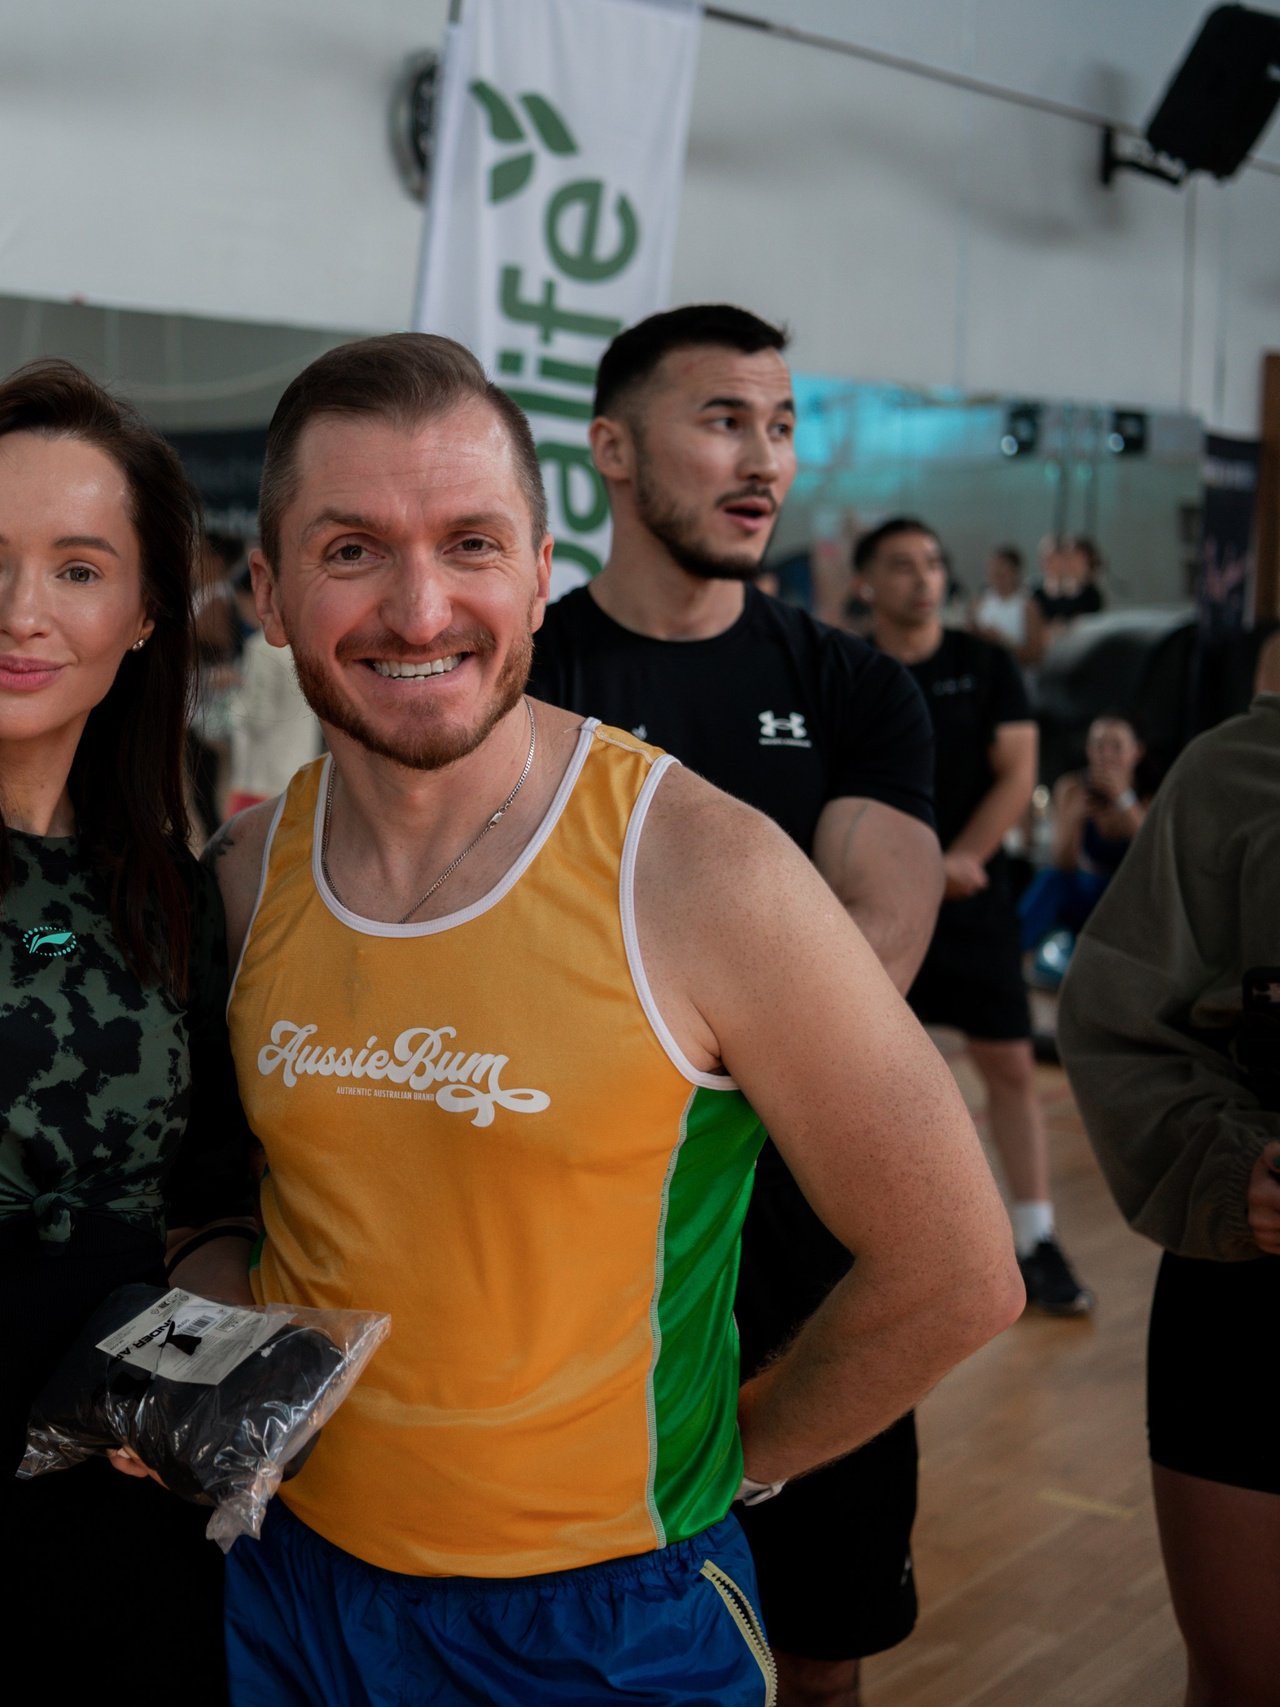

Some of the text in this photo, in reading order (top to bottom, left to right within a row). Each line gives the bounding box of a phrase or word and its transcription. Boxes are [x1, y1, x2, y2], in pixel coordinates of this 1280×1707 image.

[258, 1020, 551, 1127] AussieBum
[336, 1086, 435, 1102] AUTHENTIC AUSTRALIAN BRAND
